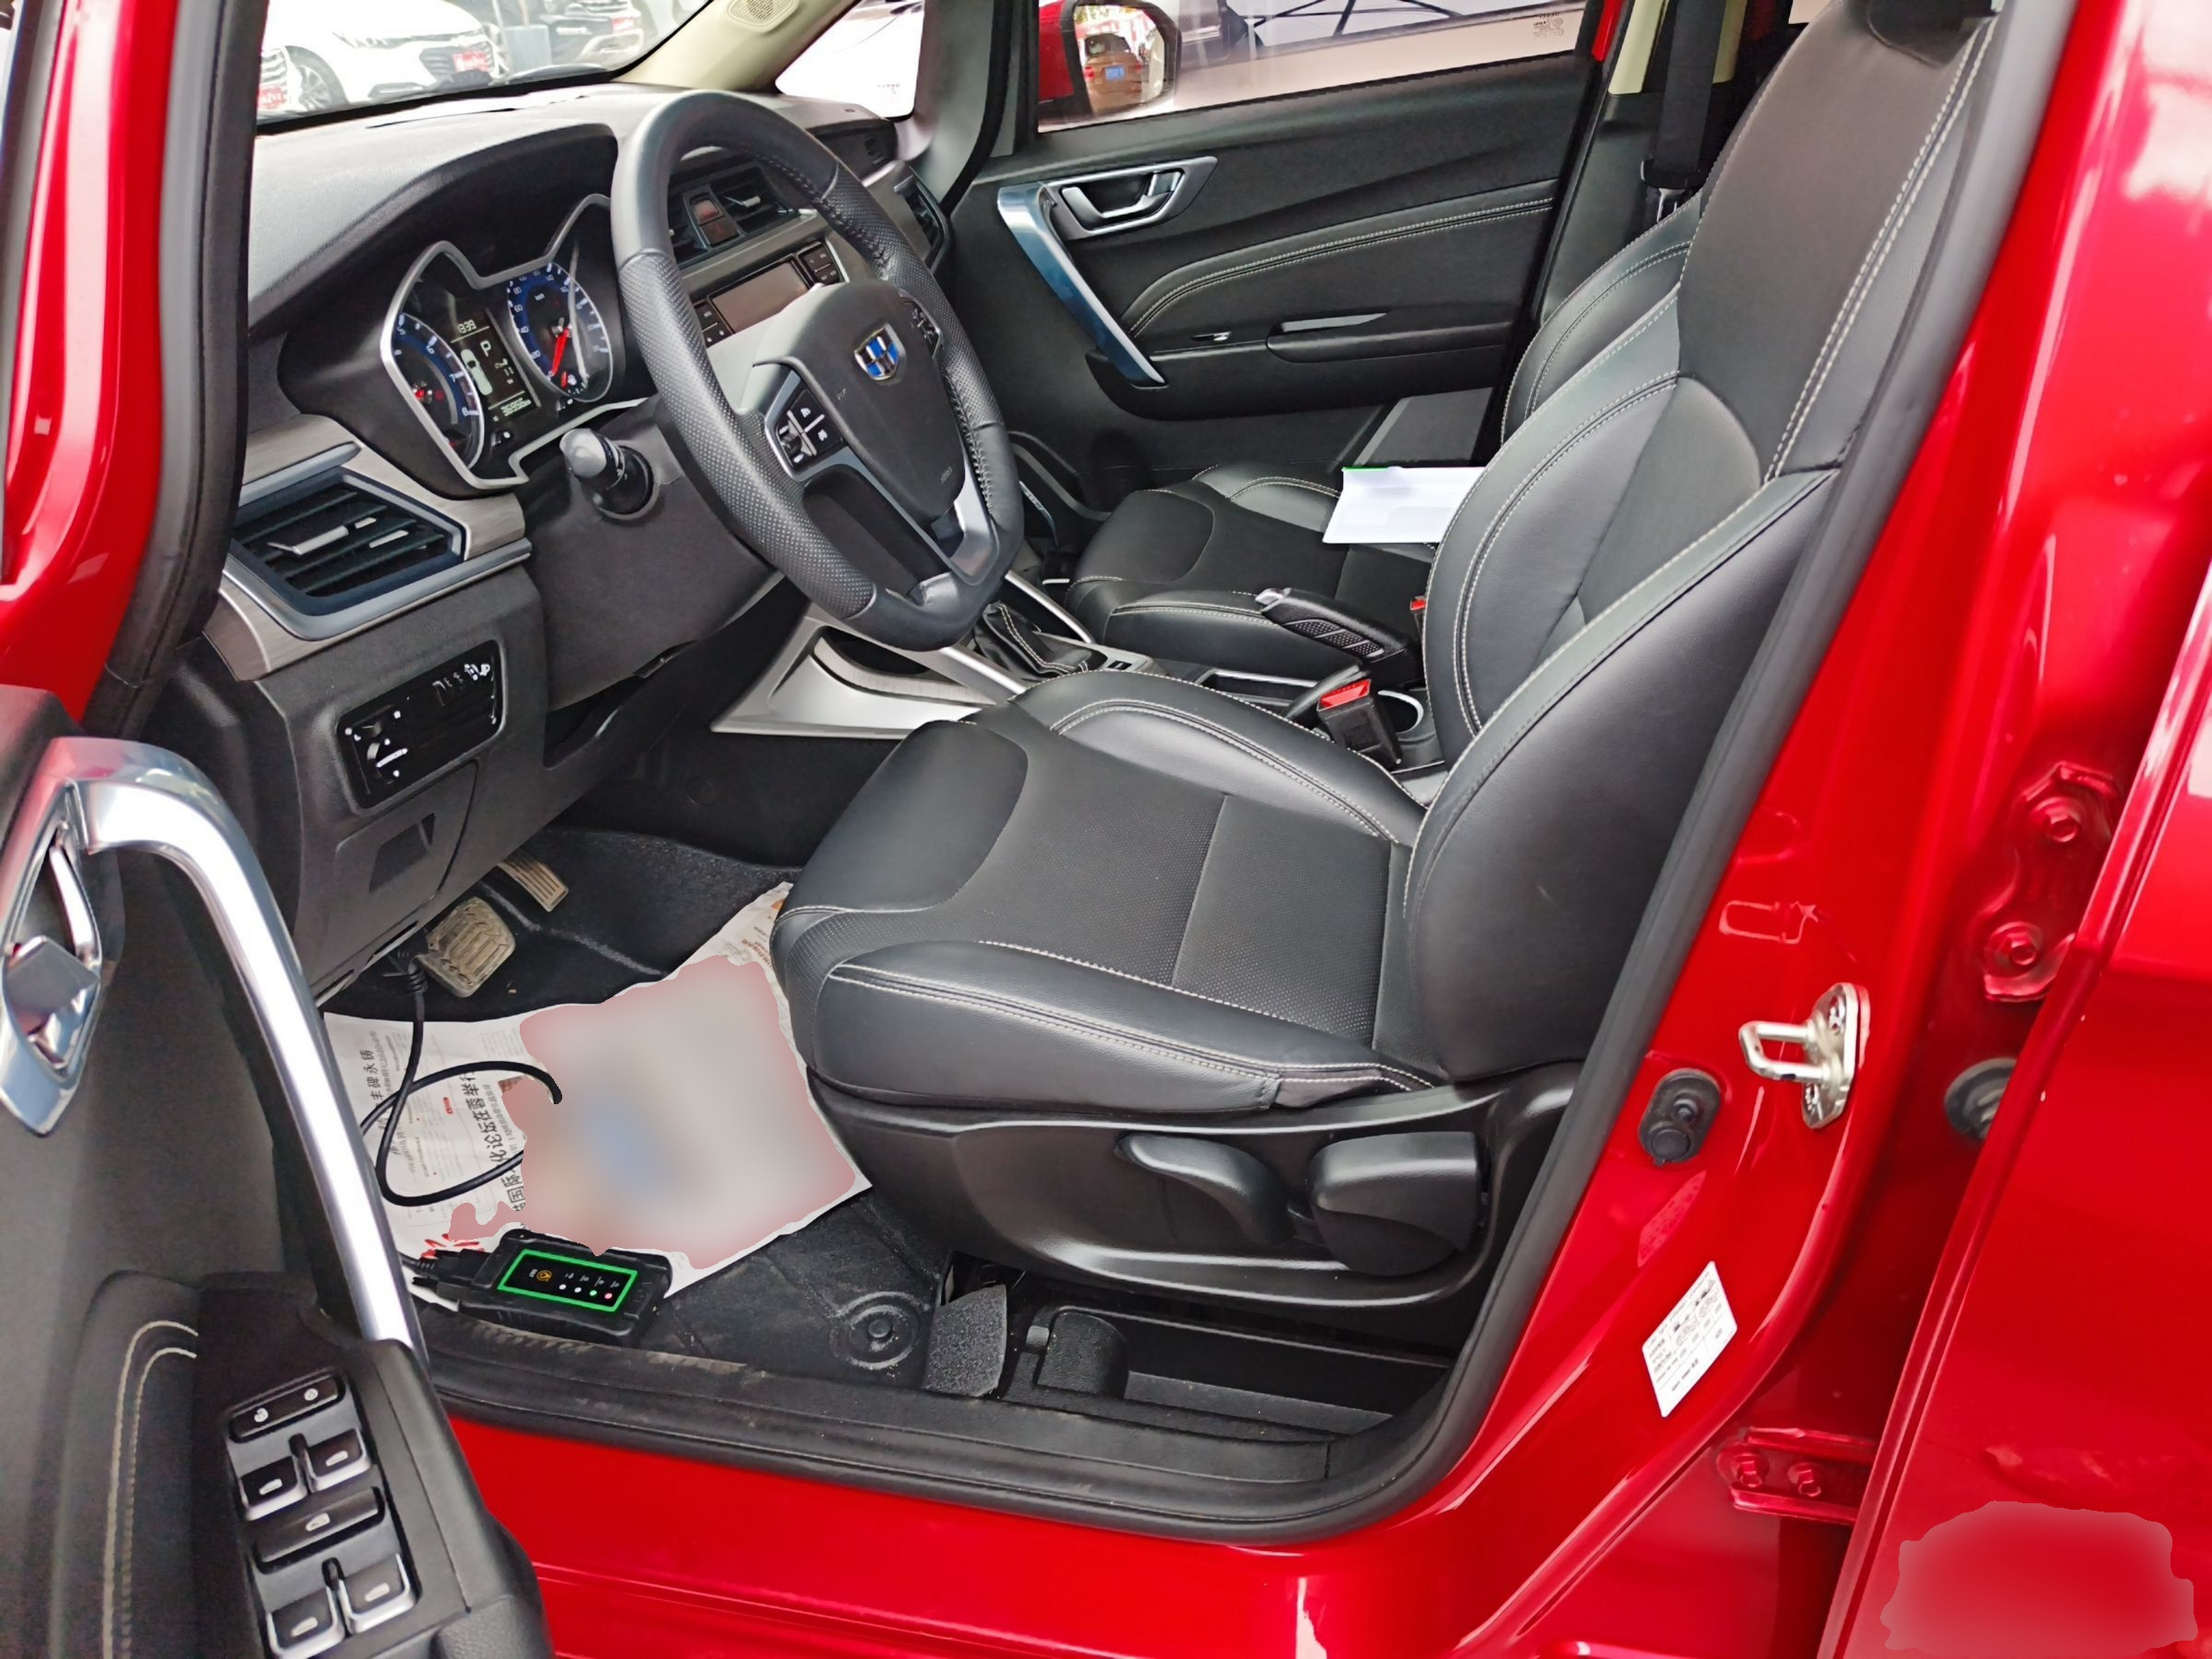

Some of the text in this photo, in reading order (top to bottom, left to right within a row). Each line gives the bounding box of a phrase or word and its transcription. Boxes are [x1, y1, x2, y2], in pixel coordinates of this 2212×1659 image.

[426, 346, 434, 354] 6
[480, 340, 491, 357] P
[449, 374, 456, 382] 7
[462, 407, 468, 416] 8
[460, 1072, 526, 1211] 国际化论坛在蓉举
